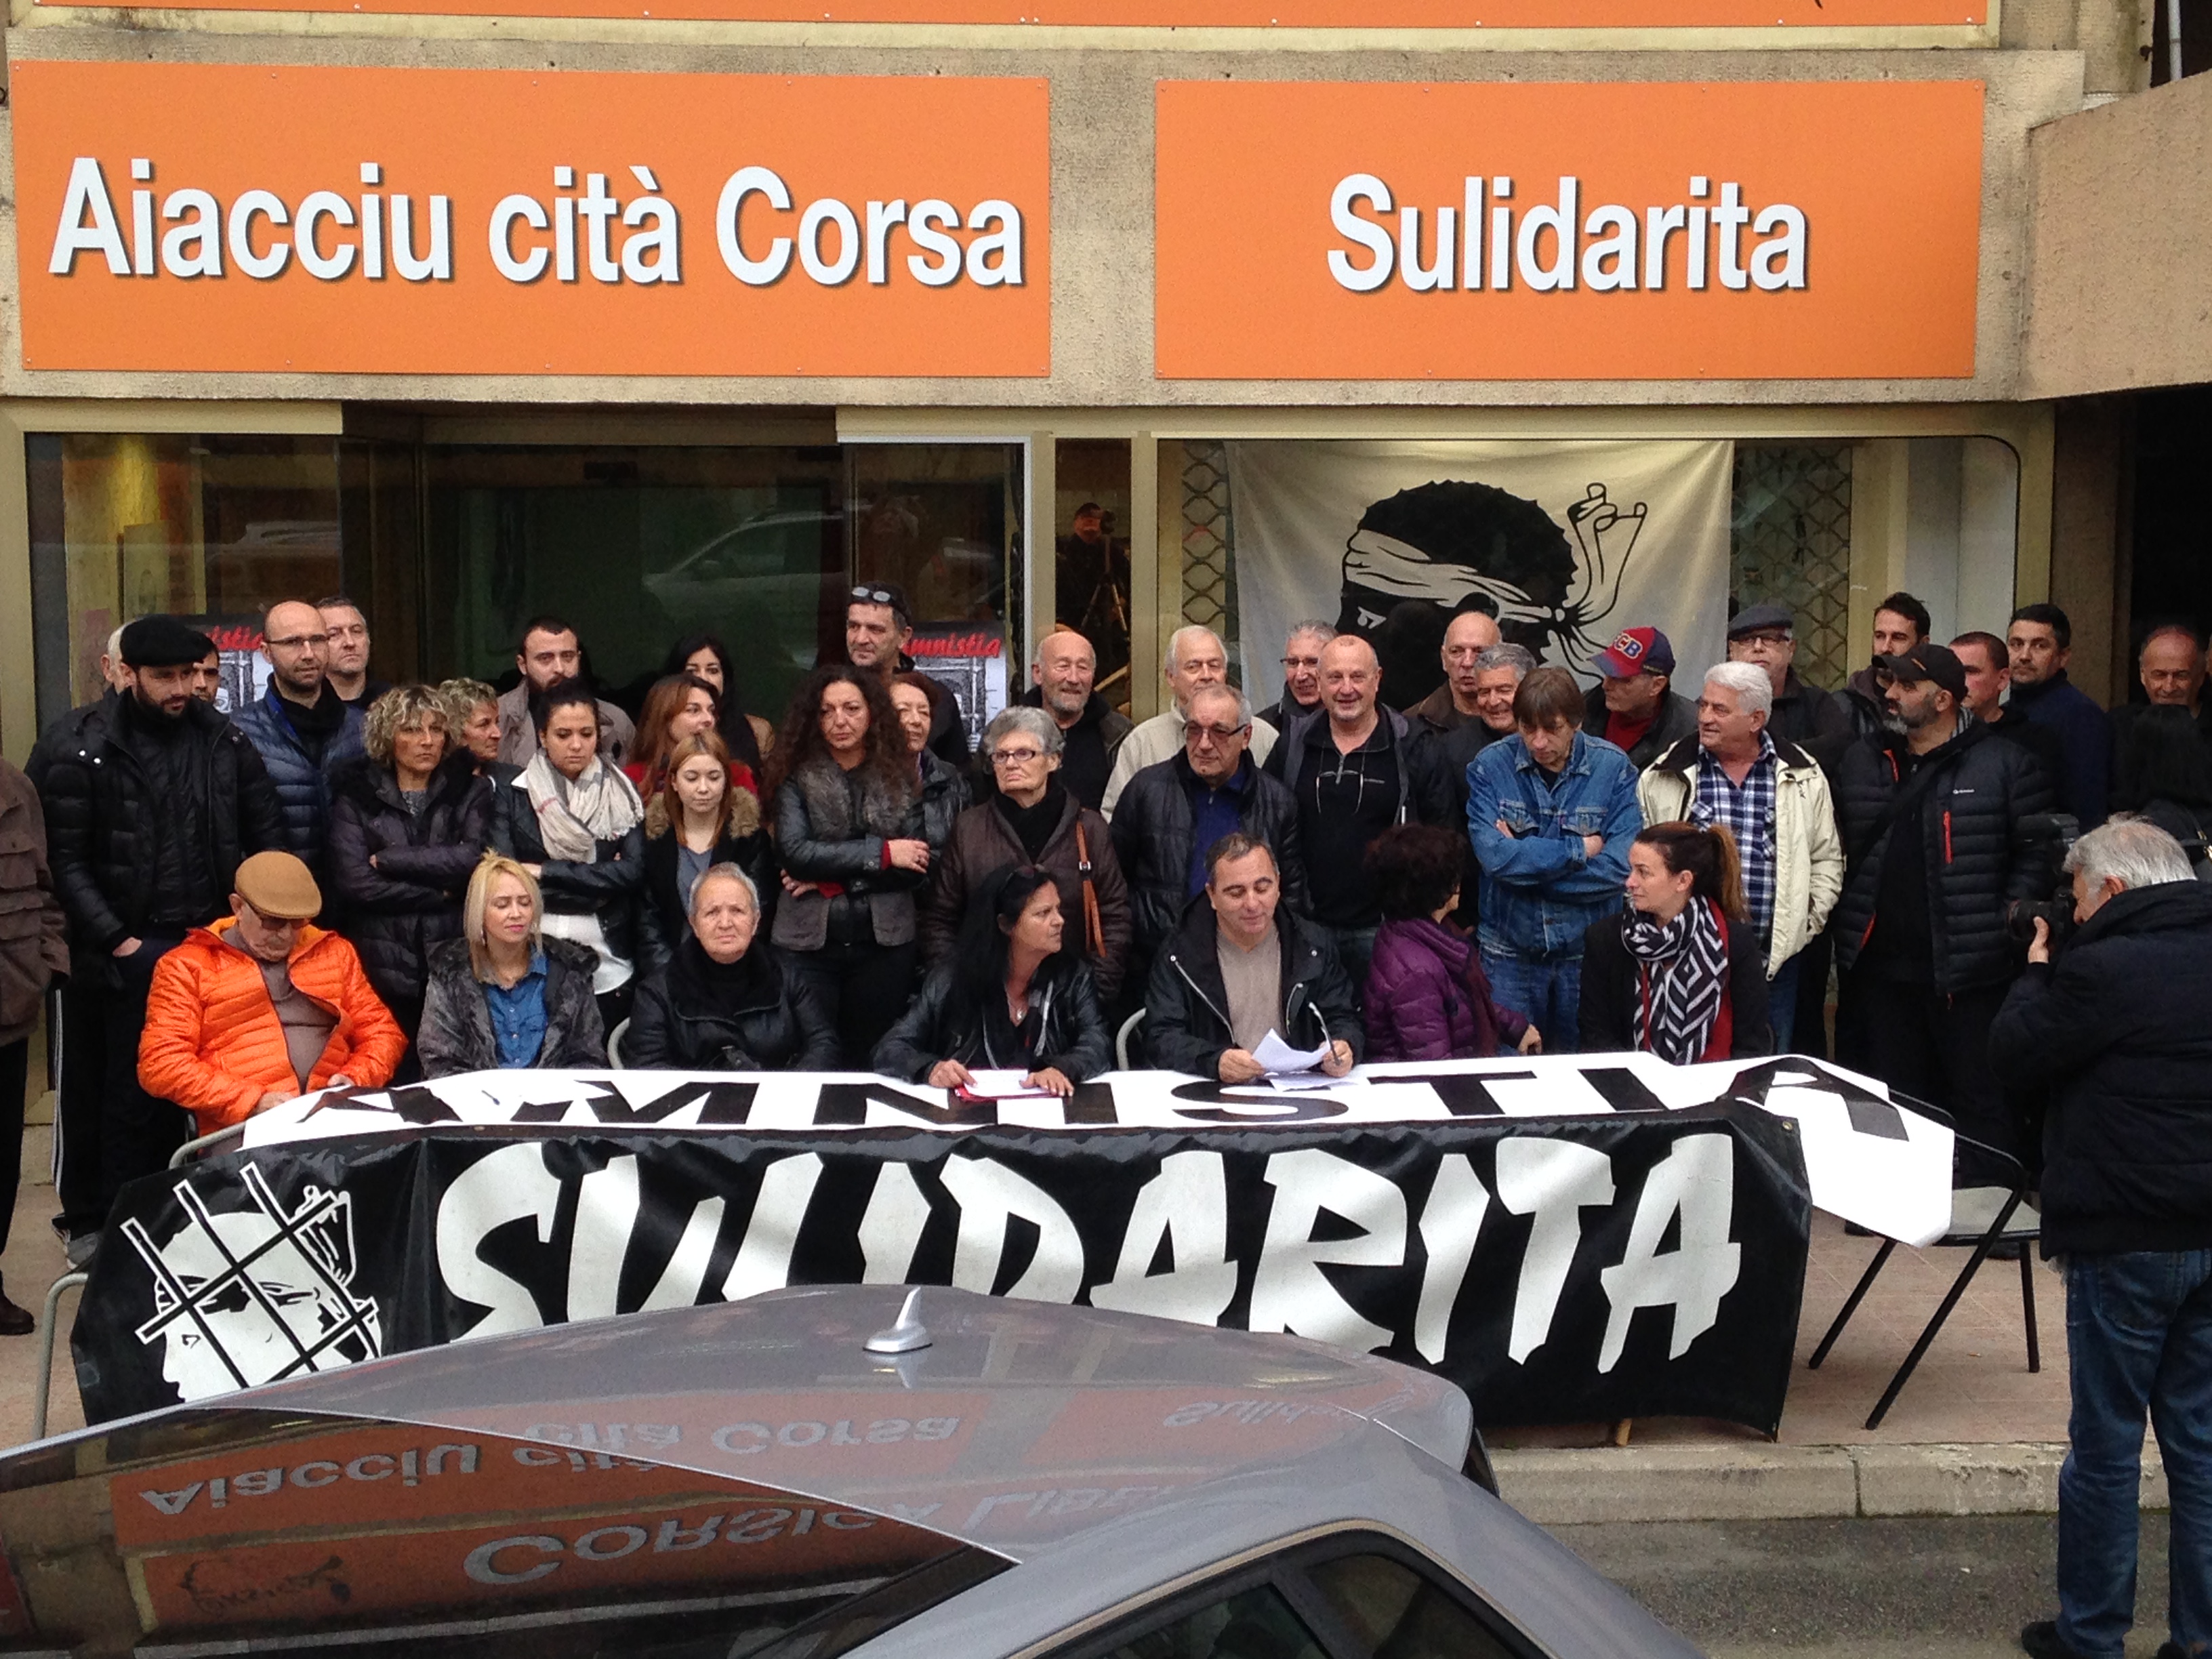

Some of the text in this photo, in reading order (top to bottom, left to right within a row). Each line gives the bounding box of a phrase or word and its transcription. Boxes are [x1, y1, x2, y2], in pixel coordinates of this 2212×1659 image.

[49, 158, 1023, 286] Aiacciu cità Corsa
[1328, 174, 1807, 291] Sulidarita
